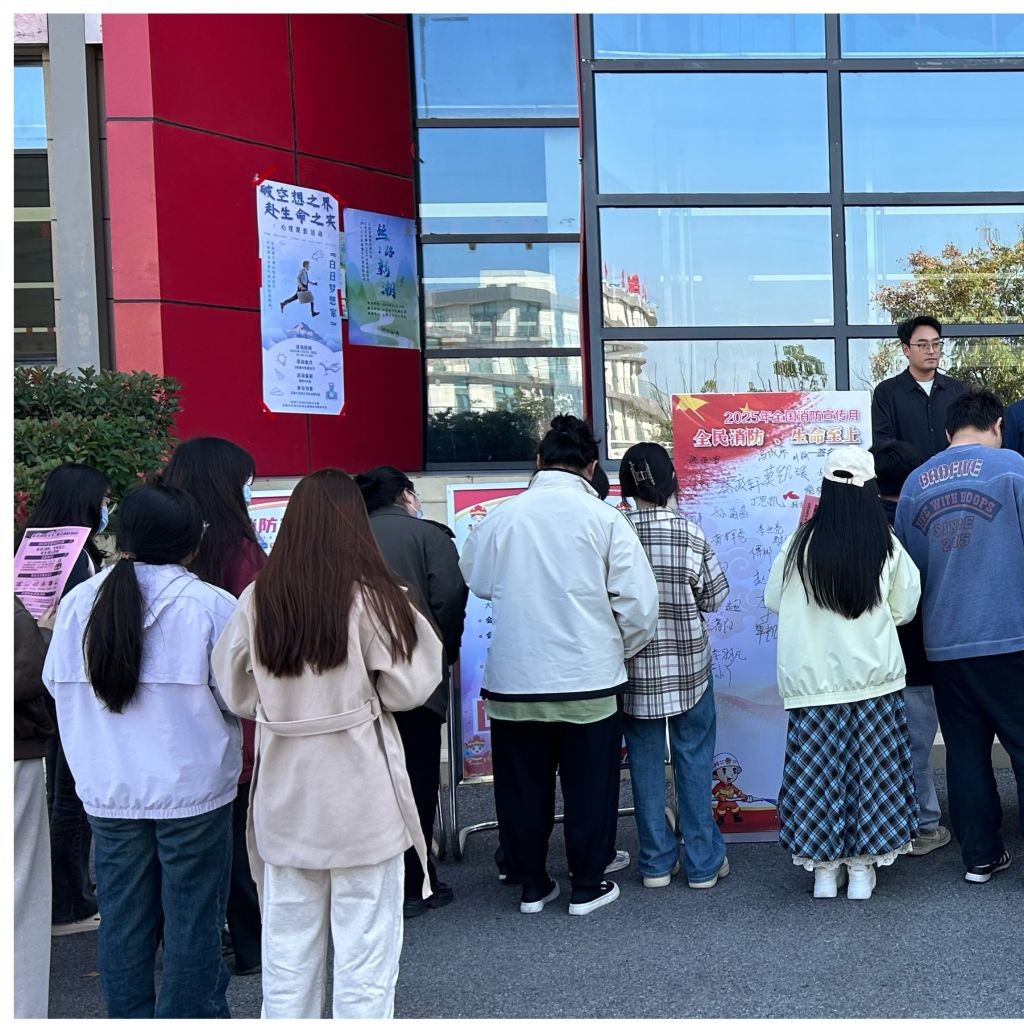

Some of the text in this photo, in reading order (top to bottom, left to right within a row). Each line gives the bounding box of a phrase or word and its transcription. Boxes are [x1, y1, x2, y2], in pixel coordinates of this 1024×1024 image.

[260, 184, 333, 212] 破空想之界
[264, 201, 337, 231] 赴生命之实
[723, 408, 861, 426] 2025年全国消防宣传月
[692, 427, 862, 448] 全民消防、生命至上
[960, 491, 996, 513] HOOPS
